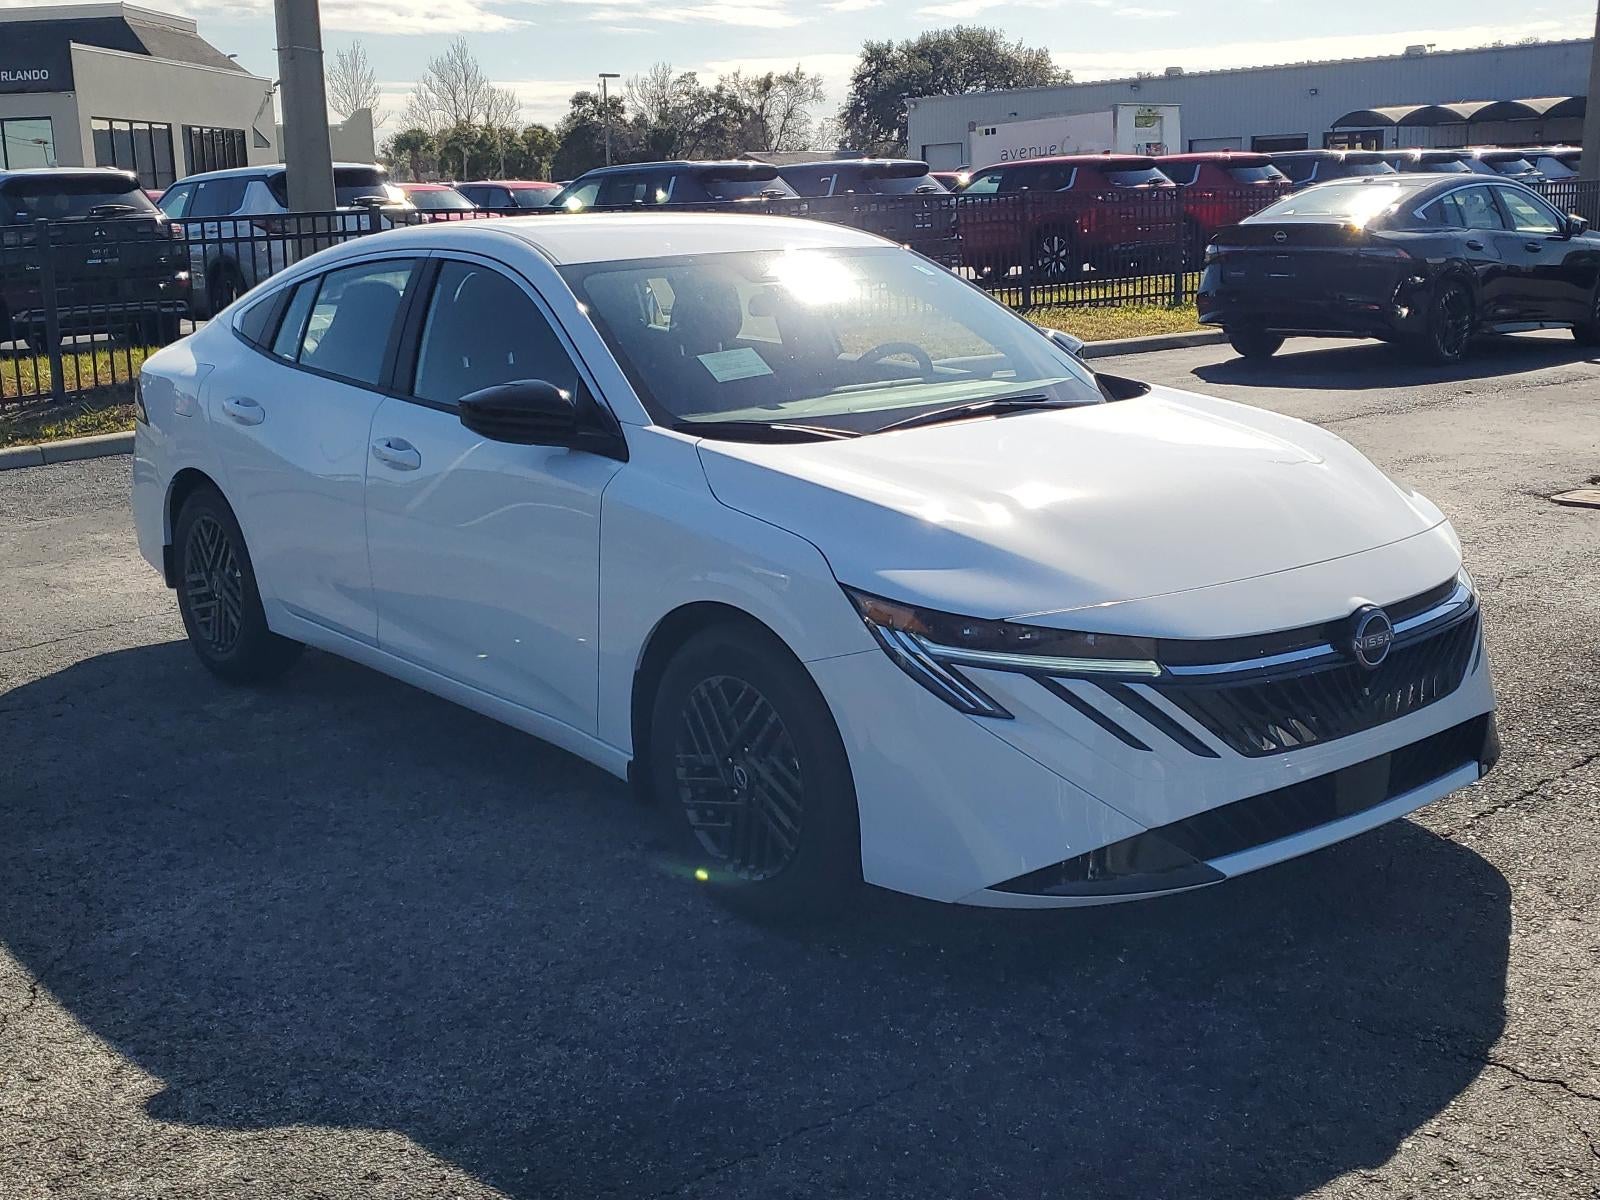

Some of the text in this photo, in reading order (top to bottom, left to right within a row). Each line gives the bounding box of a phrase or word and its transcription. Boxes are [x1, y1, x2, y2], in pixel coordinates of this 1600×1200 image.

[0, 69, 49, 81] RLANDO
[1000, 144, 1057, 161] avenue
[1354, 630, 1396, 650] NISSAN
